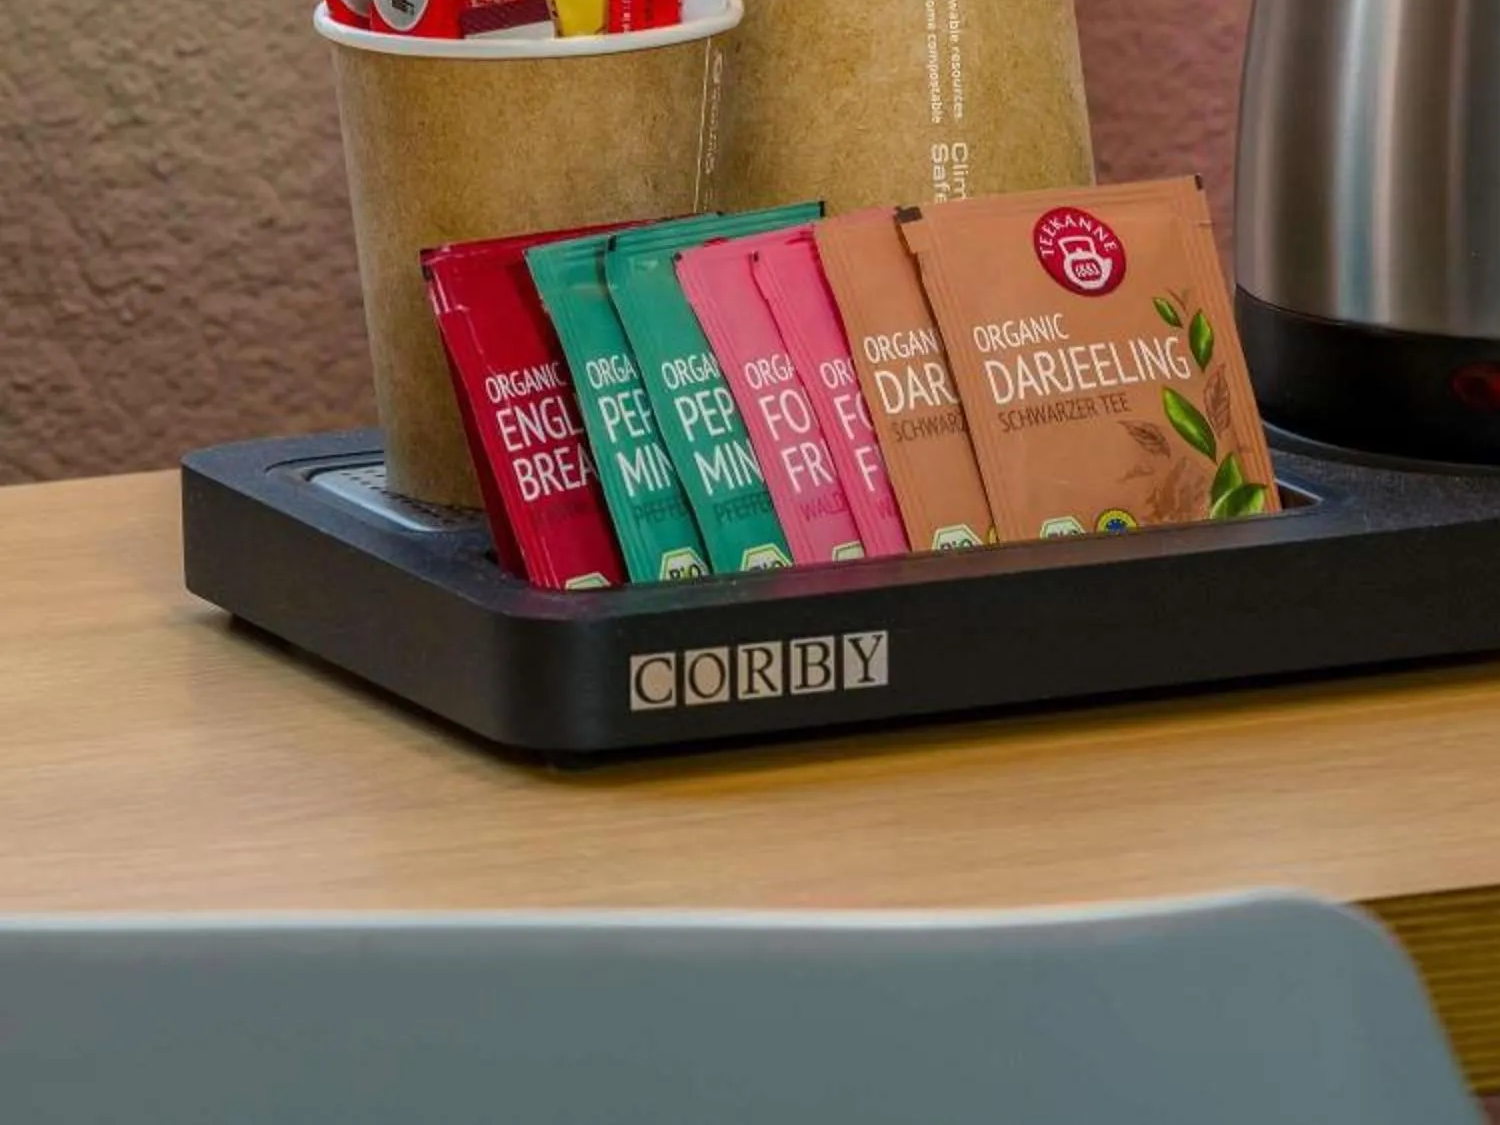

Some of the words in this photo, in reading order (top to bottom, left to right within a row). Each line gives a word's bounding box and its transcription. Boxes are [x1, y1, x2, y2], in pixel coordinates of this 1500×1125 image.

[925, 33, 944, 124] compostable
[951, 45, 966, 119] resources
[1039, 214, 1118, 259] TEEKANNE
[973, 313, 1069, 353] ORGANIC
[485, 361, 567, 405] ORGANIC
[874, 362, 960, 415] DAR
[984, 336, 1191, 405] DARJEELING
[495, 394, 585, 453] ENGL
[998, 399, 1096, 433] SCHWARZER
[1099, 392, 1133, 416] TEE
[633, 633, 885, 705] CORBY
